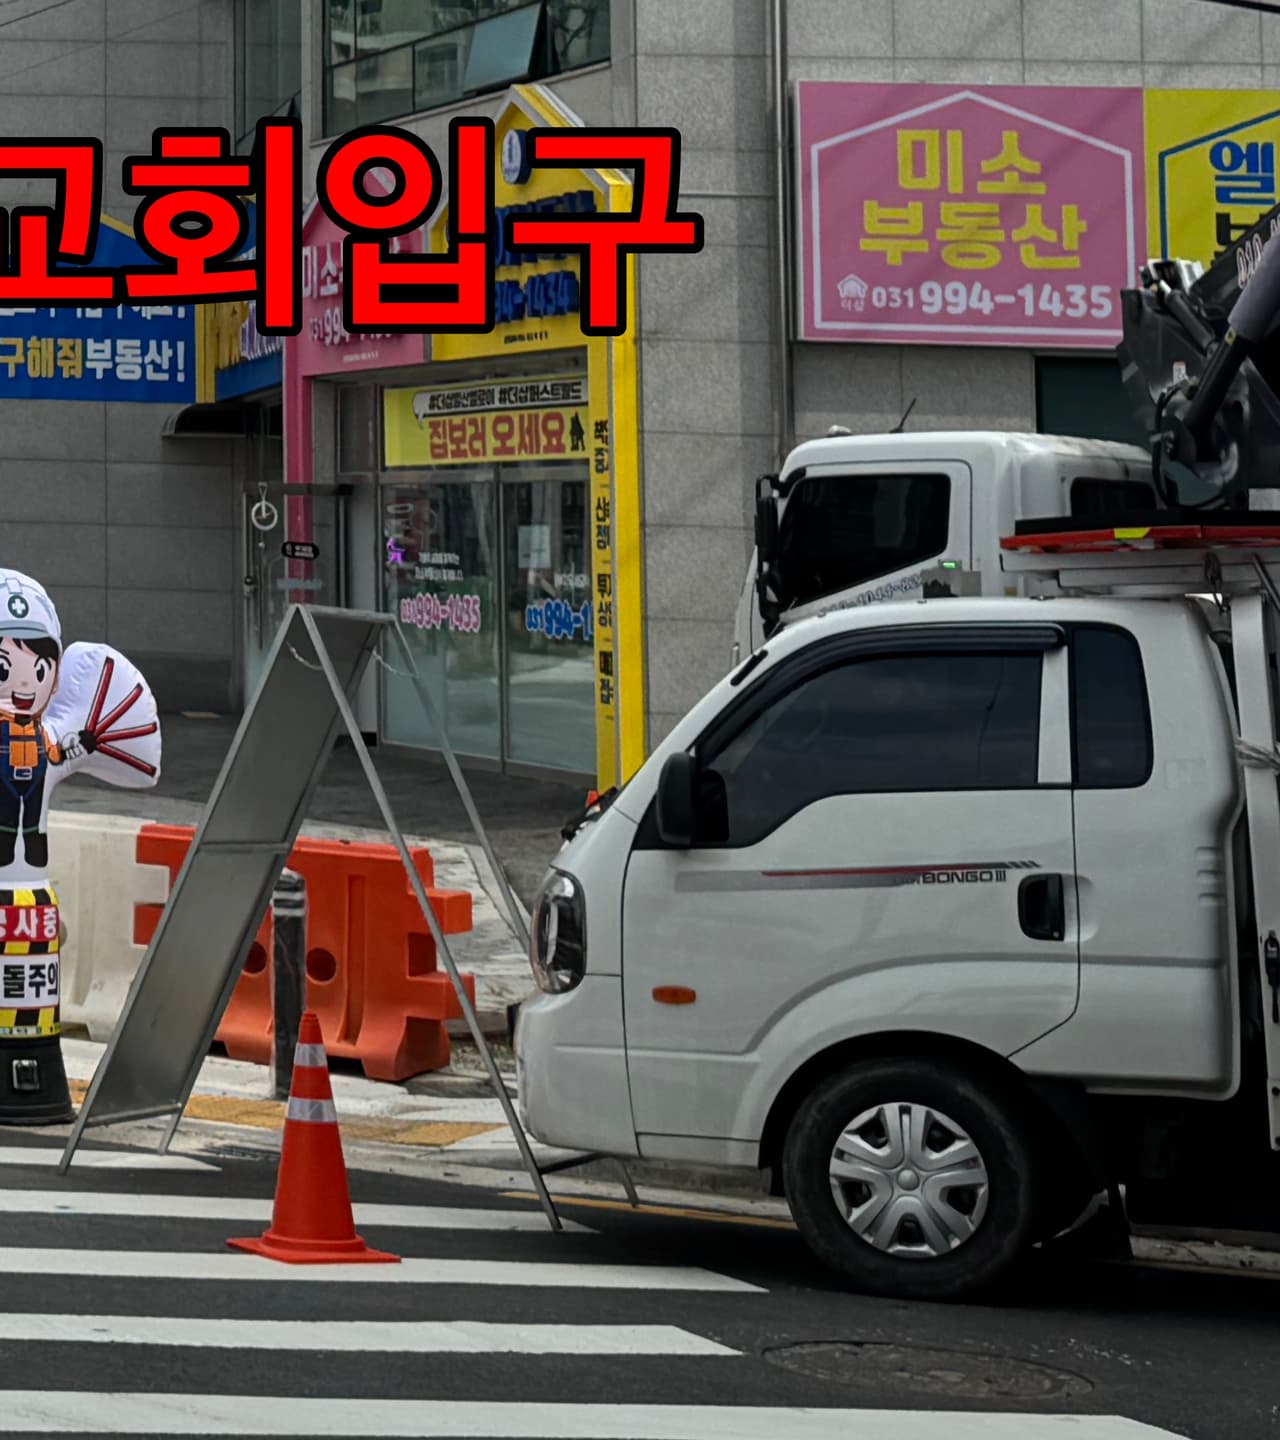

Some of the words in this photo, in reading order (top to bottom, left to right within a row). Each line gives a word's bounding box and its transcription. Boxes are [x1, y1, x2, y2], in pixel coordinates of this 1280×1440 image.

[897, 128, 1046, 195] 미소
[859, 200, 1087, 270] 부동산
[872, 286, 914, 308] 031
[919, 280, 1112, 318] 994-1435
[428, 416, 487, 460] 집보러
[491, 411, 567, 457] 오세요
[415, 592, 481, 633] 994-1435
[543, 598, 592, 641] 994-1
[921, 870, 993, 885] BONGO
